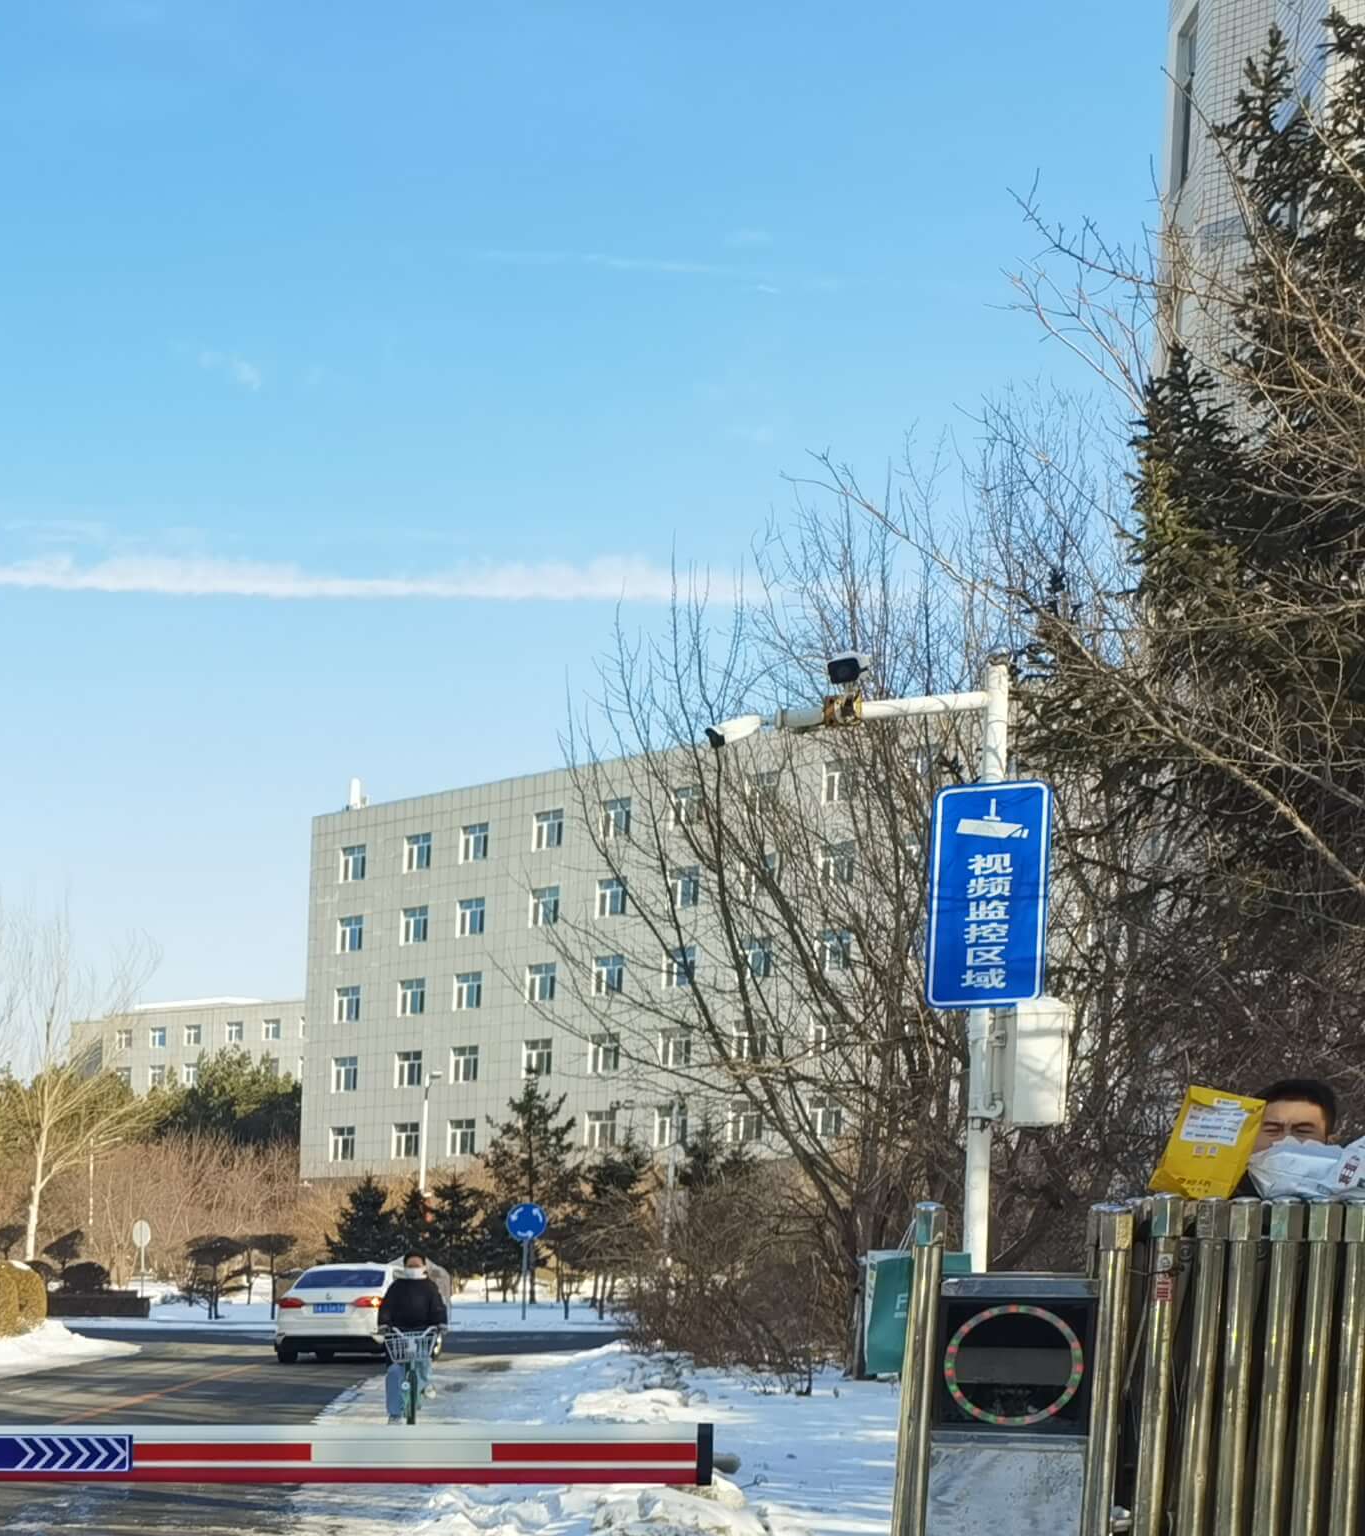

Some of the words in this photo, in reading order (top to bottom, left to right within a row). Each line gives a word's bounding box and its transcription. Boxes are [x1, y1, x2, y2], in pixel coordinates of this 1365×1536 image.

[961, 853, 1013, 989] 视频监控区域
